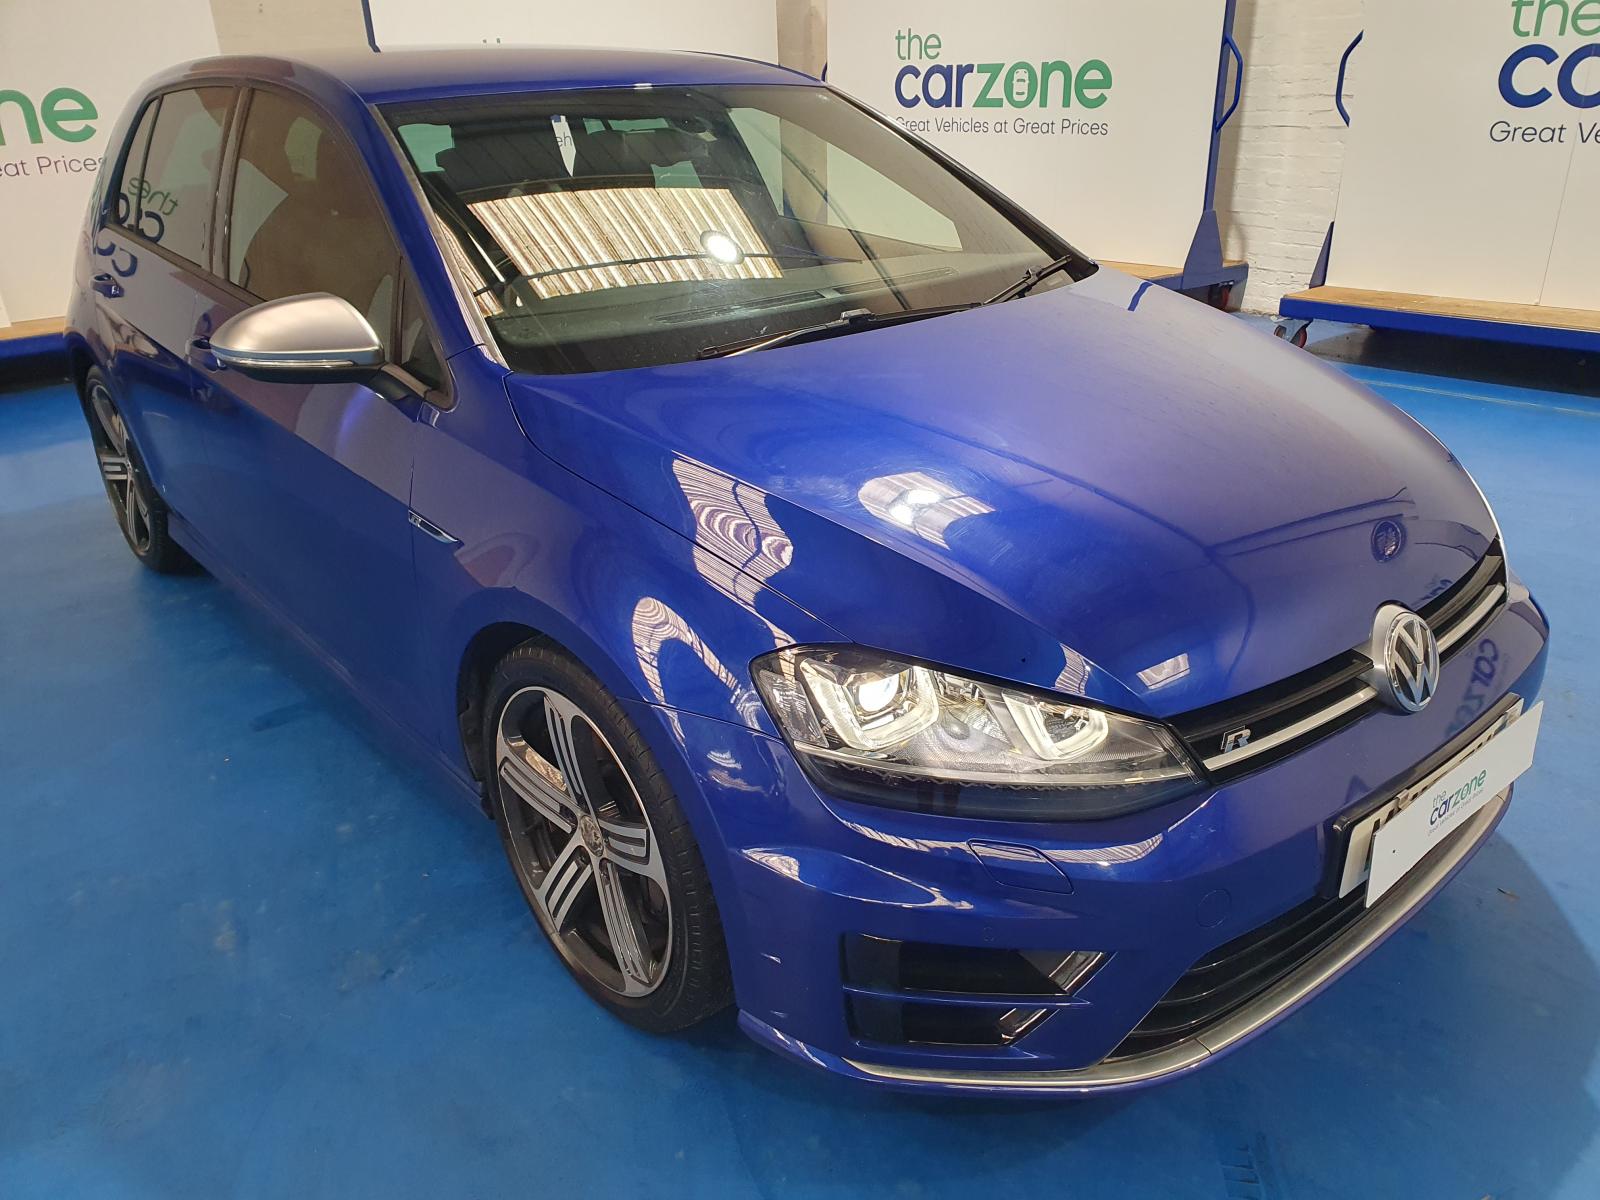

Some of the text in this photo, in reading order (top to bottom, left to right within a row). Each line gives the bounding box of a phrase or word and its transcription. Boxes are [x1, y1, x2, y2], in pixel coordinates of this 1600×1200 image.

[1511, 0, 1600, 37] the
[895, 28, 942, 60] the
[895, 59, 1113, 109] carzone
[935, 117, 989, 133] Vehicles
[994, 119, 1008, 134] at
[1013, 117, 1055, 135] Great
[1061, 118, 1108, 136] Prices
[1489, 121, 1566, 143] Great
[0, 155, 103, 177] at Price
[1430, 769, 1487, 826] carzone
